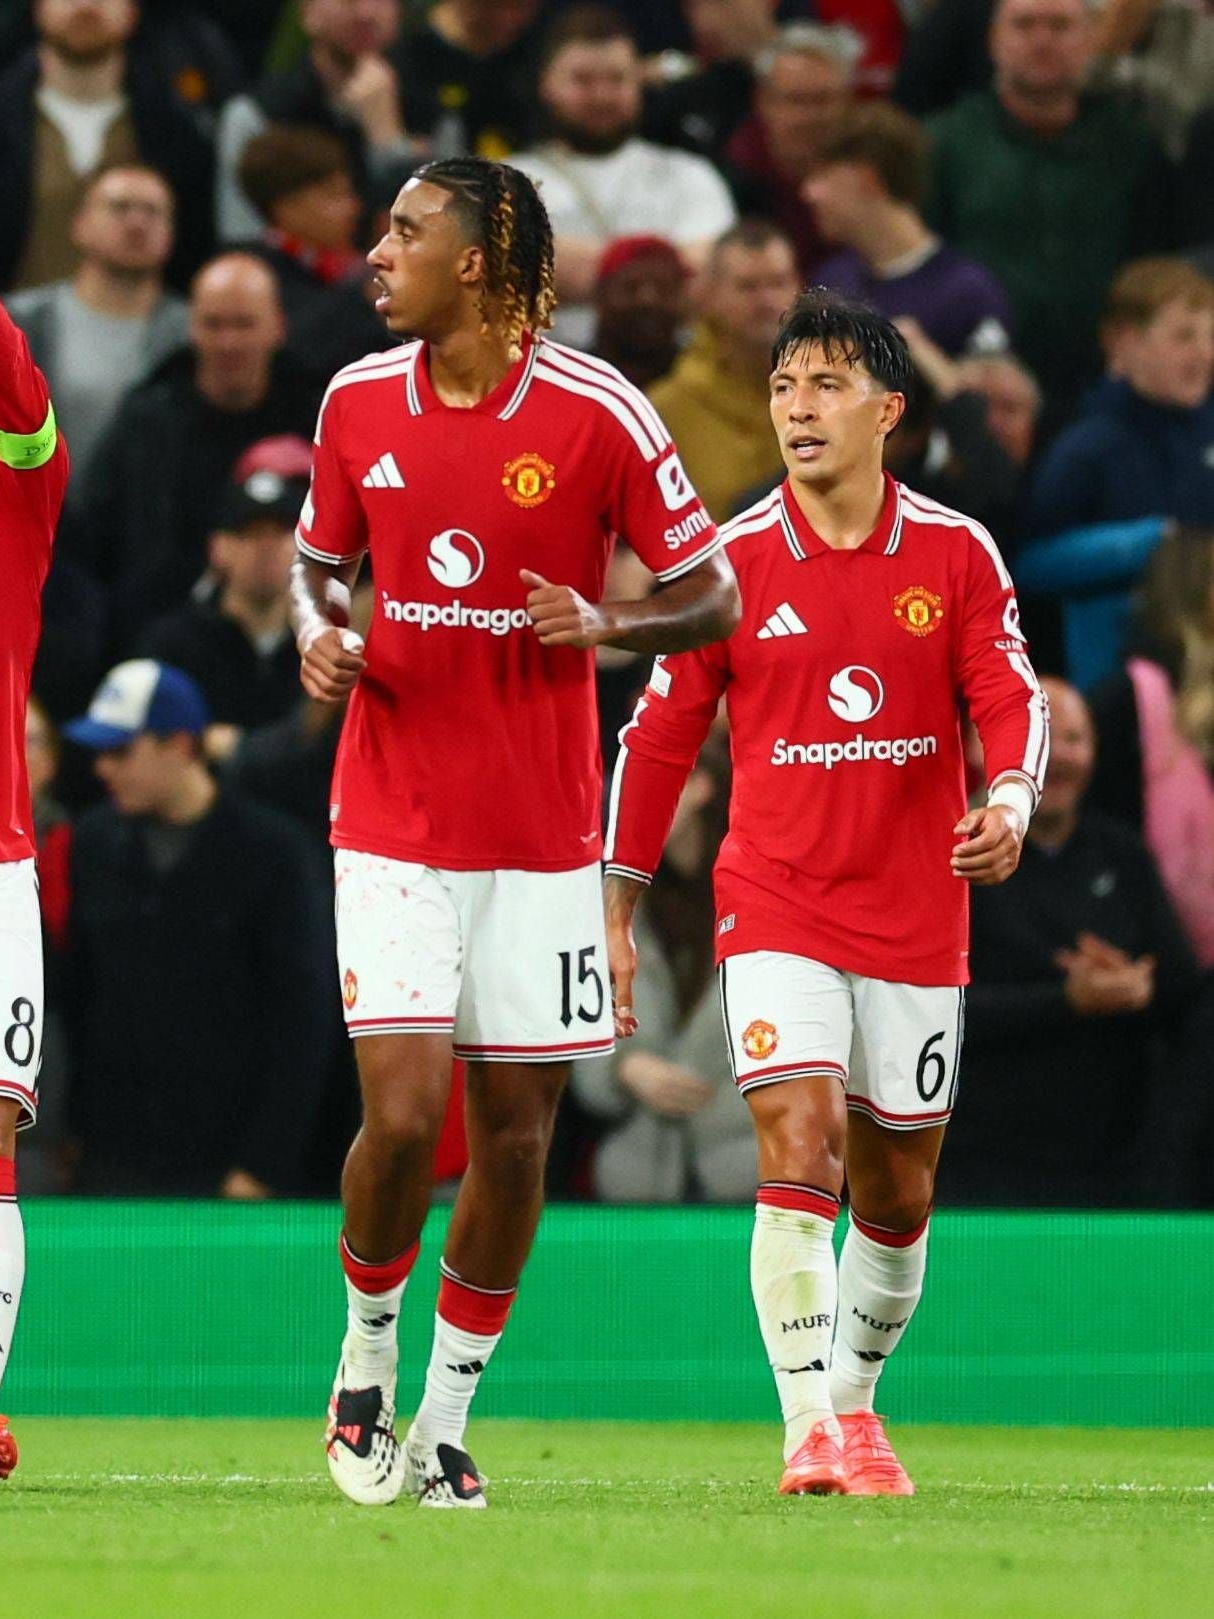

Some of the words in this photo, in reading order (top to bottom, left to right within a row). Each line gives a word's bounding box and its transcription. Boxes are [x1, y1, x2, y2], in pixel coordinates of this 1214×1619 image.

[382, 591, 532, 636] napdrago
[771, 734, 937, 770] Snapdragon
[557, 945, 604, 1029] 15
[4, 996, 35, 1067] 8
[916, 1031, 946, 1102] 6
[782, 1314, 831, 1333] MUFC
